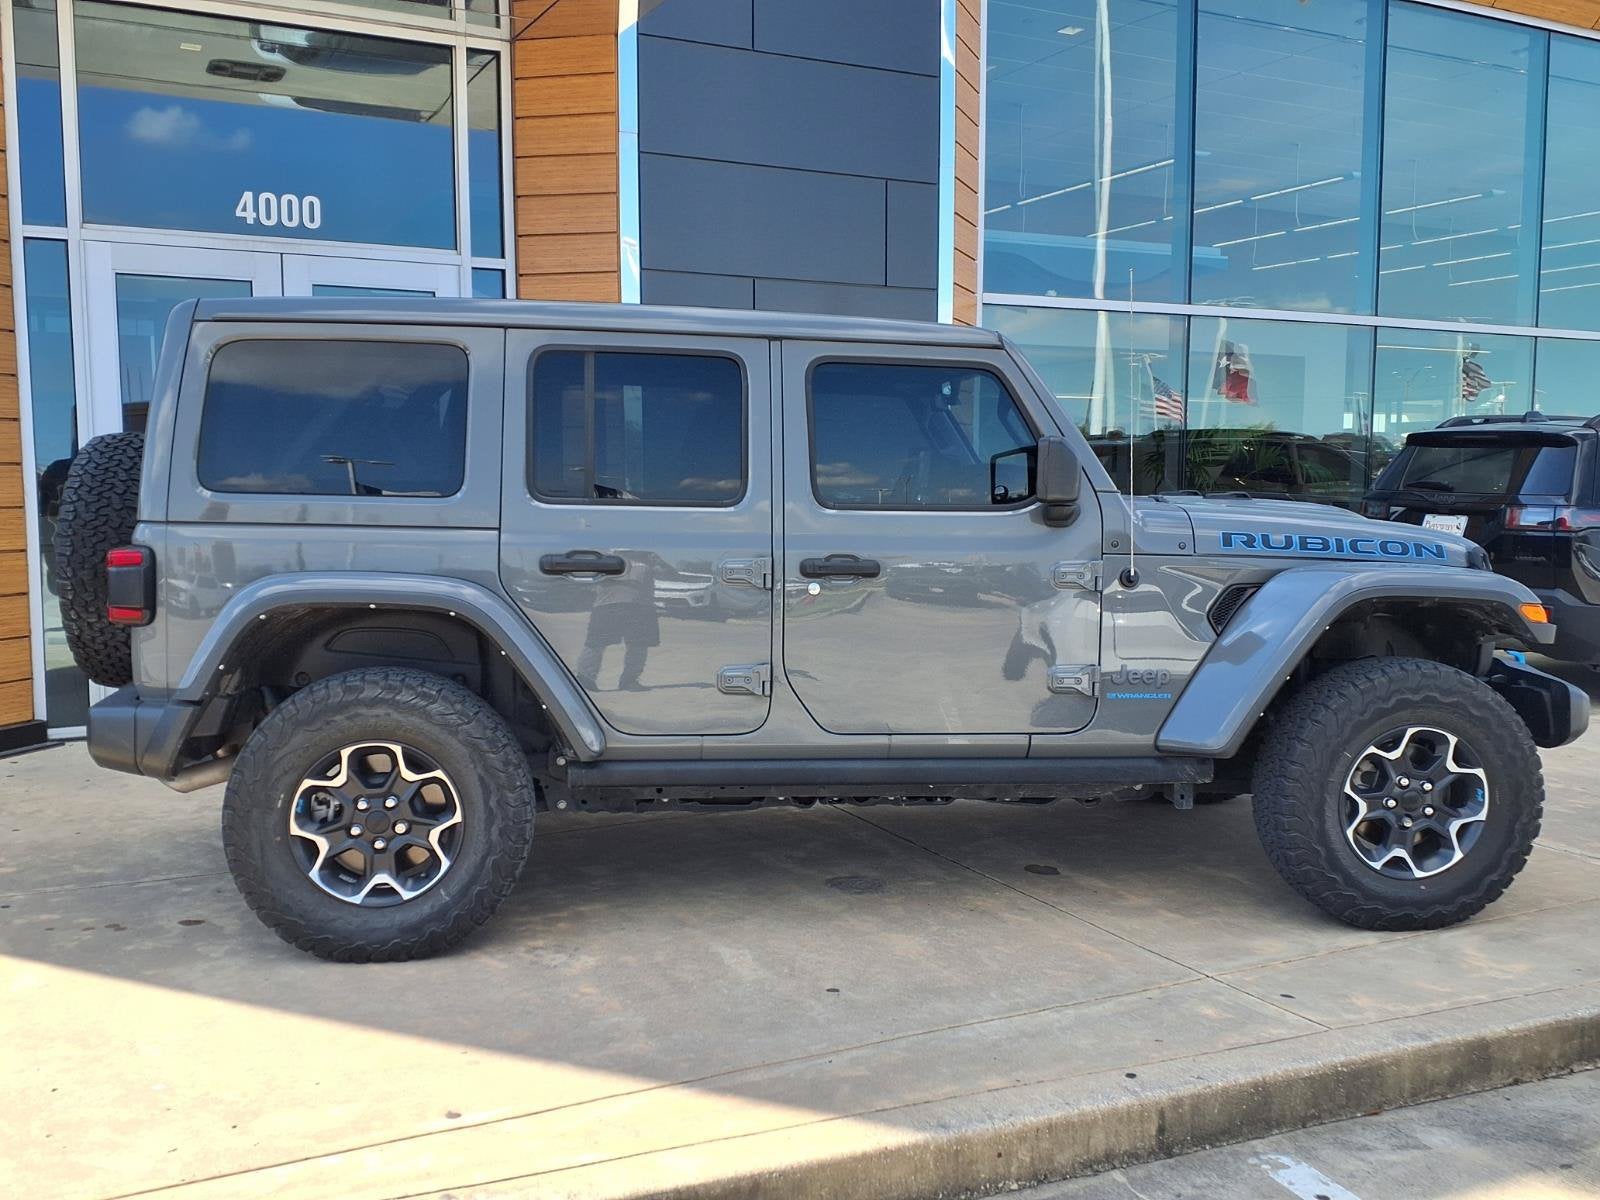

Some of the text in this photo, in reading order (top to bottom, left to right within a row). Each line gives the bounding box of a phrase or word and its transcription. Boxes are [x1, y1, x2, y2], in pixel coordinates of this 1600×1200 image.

[235, 191, 321, 229] 4000
[1220, 531, 1447, 560] RUBICON
[1111, 664, 1170, 689] Jeep
